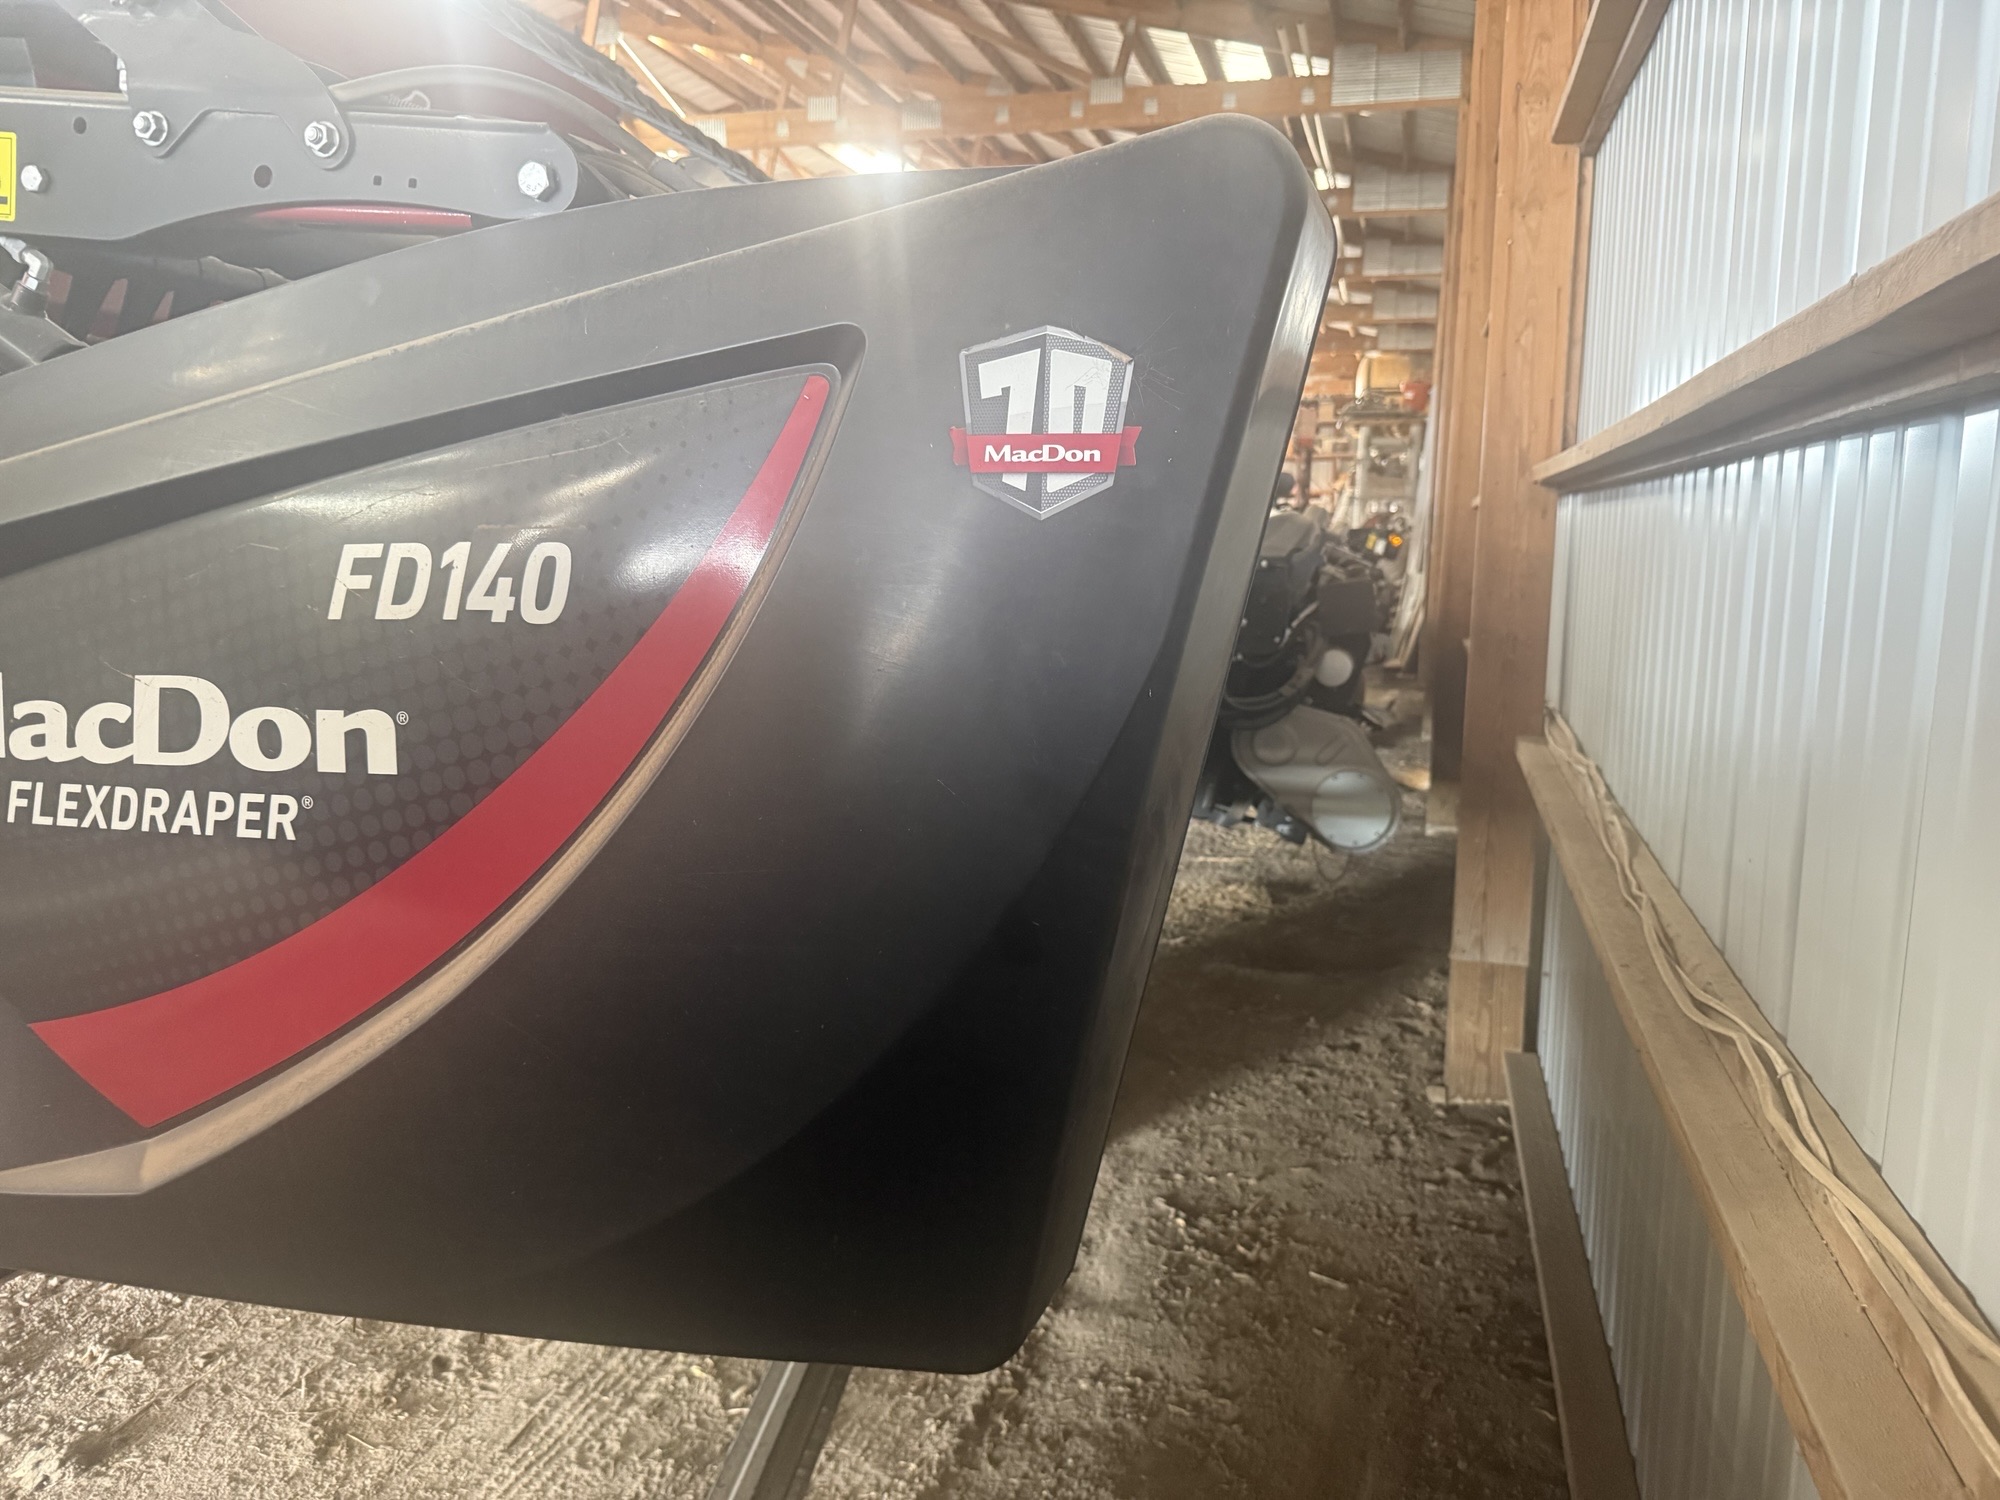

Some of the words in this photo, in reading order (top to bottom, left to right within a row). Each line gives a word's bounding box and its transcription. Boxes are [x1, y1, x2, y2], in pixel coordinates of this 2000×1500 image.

[984, 444, 1101, 462] MacDon
[327, 541, 573, 625] FD140
[0, 671, 408, 776] acDon®
